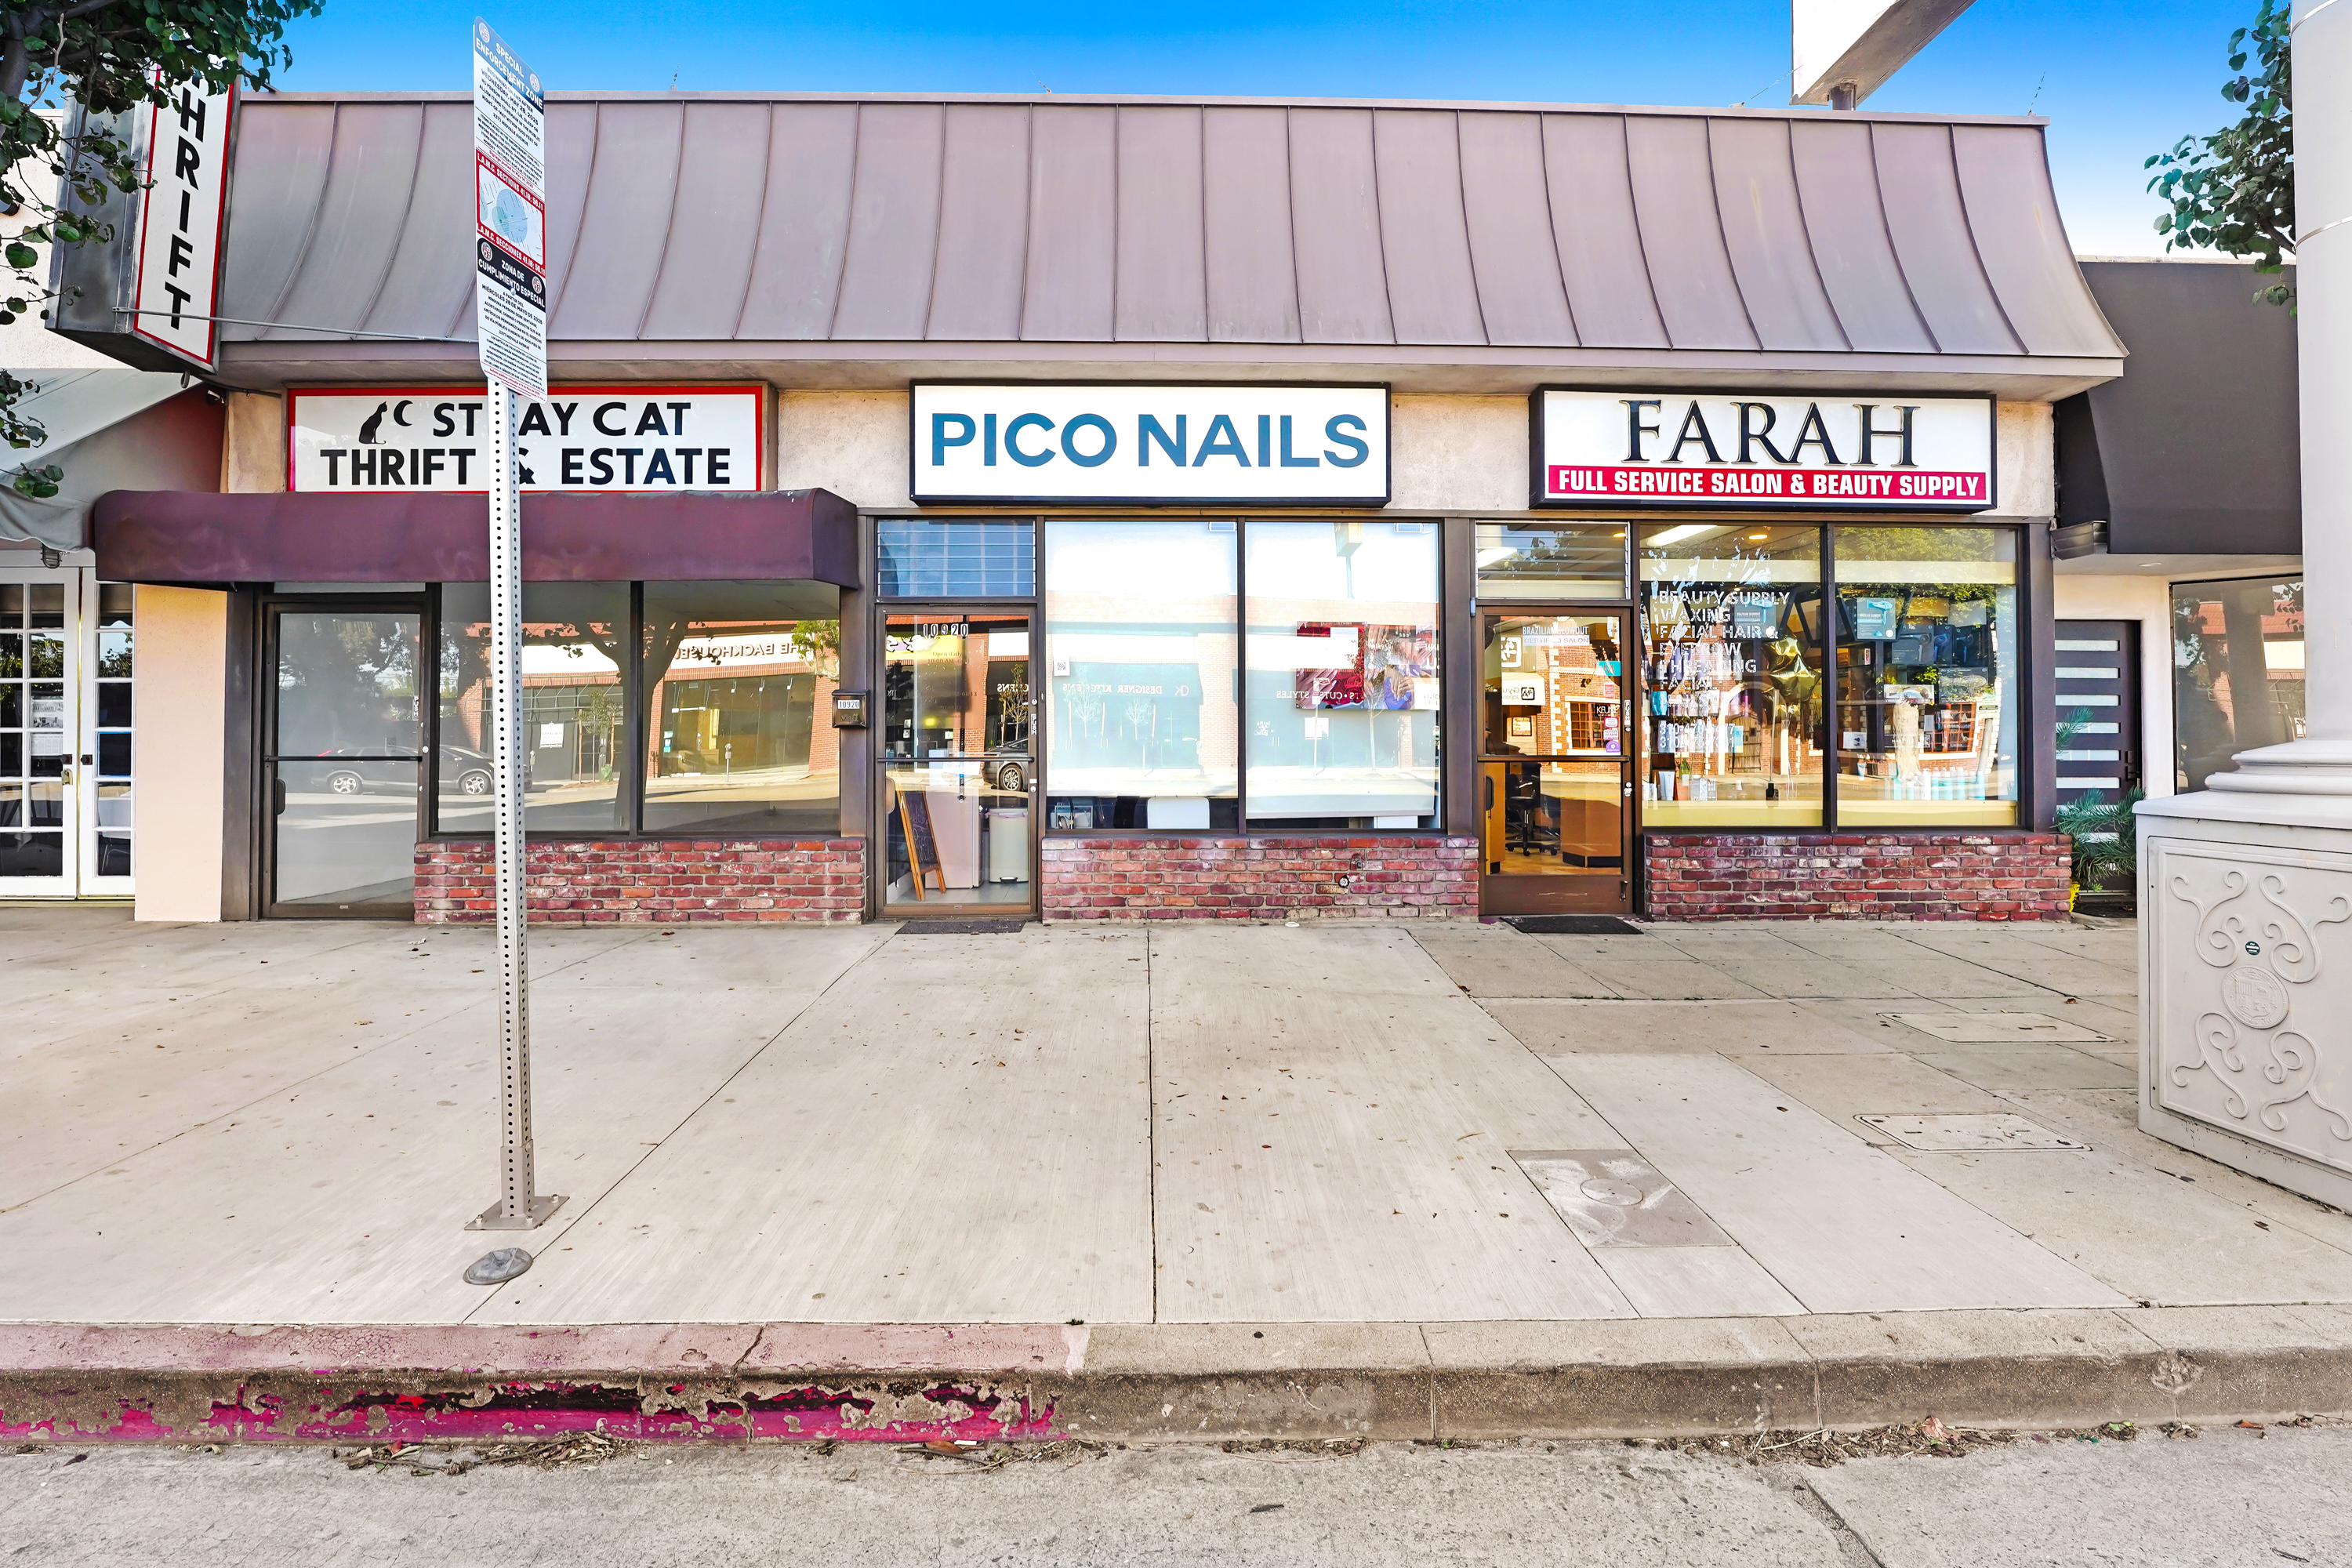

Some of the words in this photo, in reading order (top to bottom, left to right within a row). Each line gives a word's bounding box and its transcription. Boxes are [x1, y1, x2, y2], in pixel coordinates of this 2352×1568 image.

[476, 37, 524, 93] ENFORCEMENT
[526, 85, 543, 111] ZONE
[496, 42, 524, 78] SPECIAL
[481, 68, 509, 99] WEDNESDAY,
[510, 95, 518, 108] MAY
[528, 111, 538, 125] 2025
[477, 151, 495, 174] L.A.M.C.
[496, 167, 519, 192] SECTIONS
[520, 186, 531, 202] 41.18;
[532, 196, 543, 211] 56.11
[165, 75, 206, 330] HRIFT
[477, 222, 495, 241] L.A.M.C.
[496, 235, 521, 260] SECCIONES
[522, 254, 534, 269] 41.18;
[535, 263, 545, 277] 56.11
[478, 257, 519, 292] CUMPLIMIENTO
[521, 285, 544, 308] ESPECIAL
[501, 259, 516, 277] ZONA
[517, 270, 524, 282] DE
[481, 282, 504, 302] MIÉRCOLES
[517, 304, 526, 315] MAYO
[533, 315, 542, 325] 2025
[433, 401, 585, 437] STAY
[593, 401, 691, 437] CAT
[1619, 399, 1922, 468] FARAH
[932, 412, 1117, 467] PICO
[1138, 413, 1369, 468] NAILS
[321, 448, 476, 485] THRIFT
[561, 448, 731, 485] ESTATE
[1559, 470, 1607, 492] FULL
[1614, 470, 1704, 492] SERVICE
[1711, 473, 1782, 494] SALON
[1791, 474, 1805, 495] &
[1813, 474, 1893, 495] BEAUTY
[1900, 475, 1979, 496] SUPPLY
[1659, 591, 1724, 604] BEAUTY
[1730, 591, 1790, 604] SUPPLY
[1660, 608, 1730, 622] WAXING
[923, 623, 969, 637] 10920
[1523, 626, 1555, 635] BRAZILIA
[1661, 626, 1717, 638] FACIAL
[1722, 626, 1761, 638] HAIR
[1660, 677, 1717, 690] FACIAL
[839, 700, 859, 709] 10920
